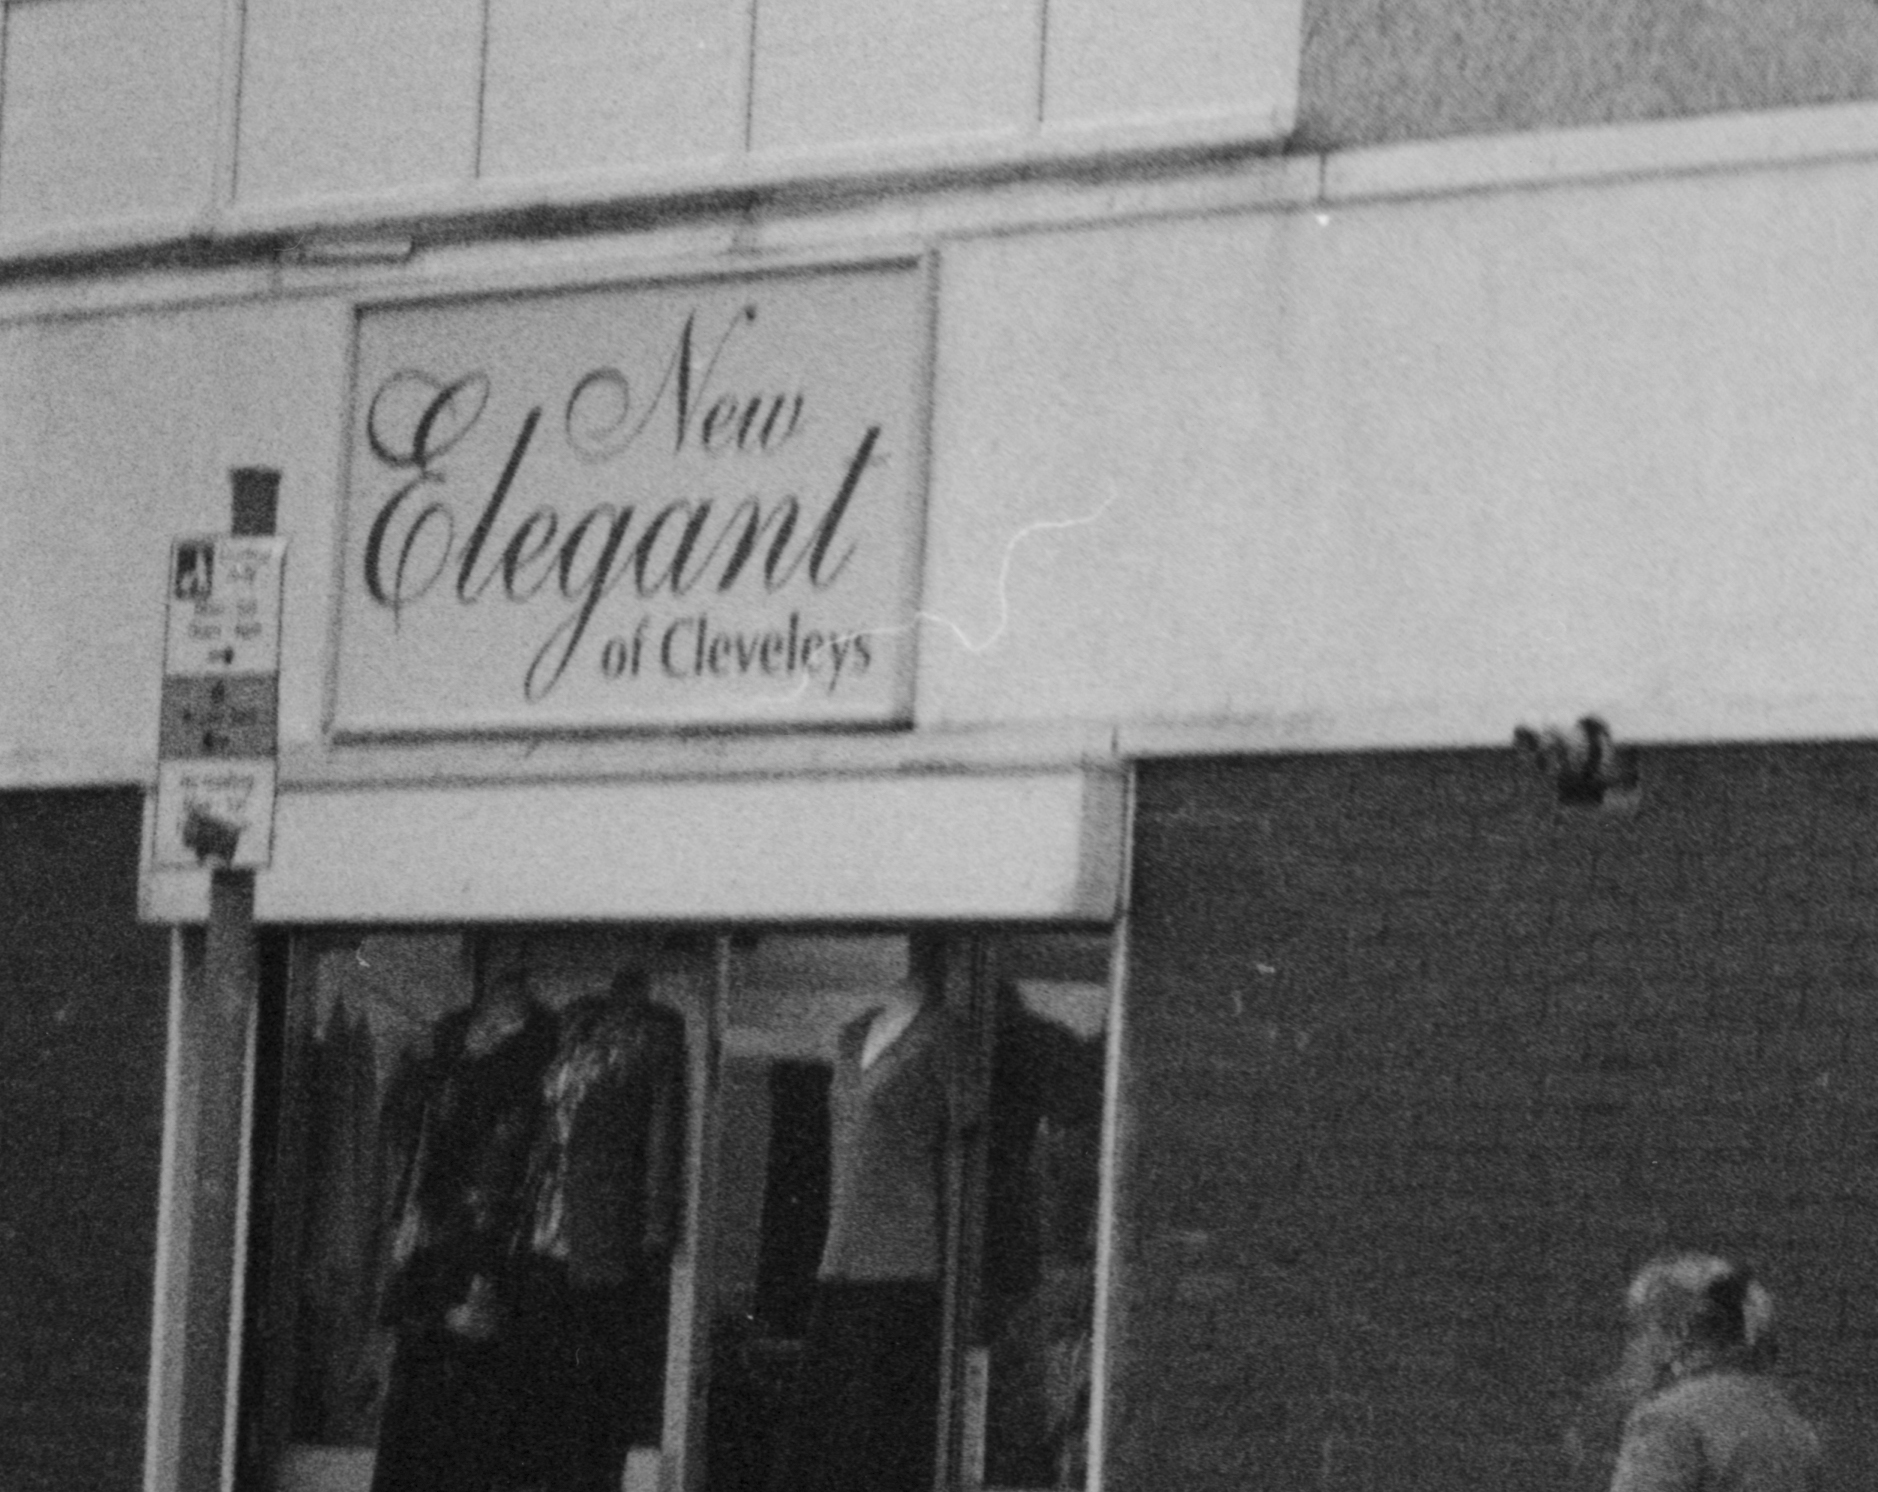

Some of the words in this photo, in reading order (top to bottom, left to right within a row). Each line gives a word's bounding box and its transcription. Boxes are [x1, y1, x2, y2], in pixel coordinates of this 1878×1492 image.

[565, 306, 803, 464] New
[363, 368, 890, 704] Elegant
[602, 613, 650, 678] of
[661, 612, 871, 694] Cleveleys
